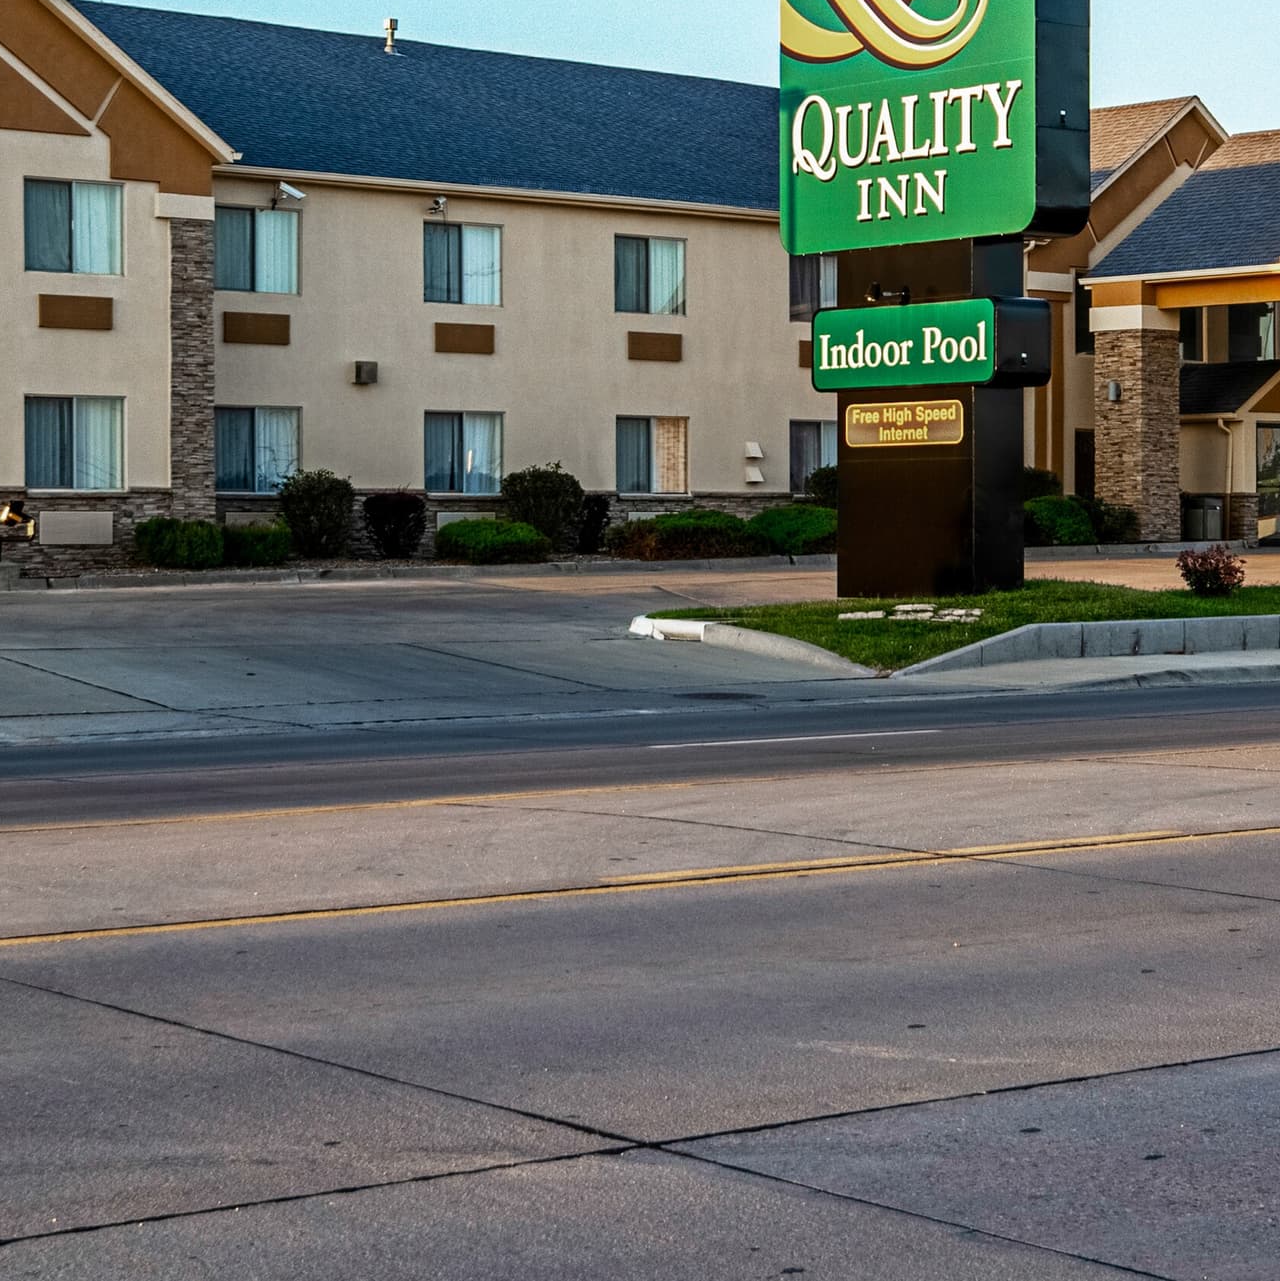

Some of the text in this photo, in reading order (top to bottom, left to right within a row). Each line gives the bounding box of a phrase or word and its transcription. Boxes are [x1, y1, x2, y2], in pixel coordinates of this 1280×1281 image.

[792, 79, 1022, 182] QUALITY
[856, 169, 947, 222] INN
[819, 320, 988, 370] Indoor Pool
[852, 404, 956, 426] Free High Speed
[879, 425, 928, 442] Internet
